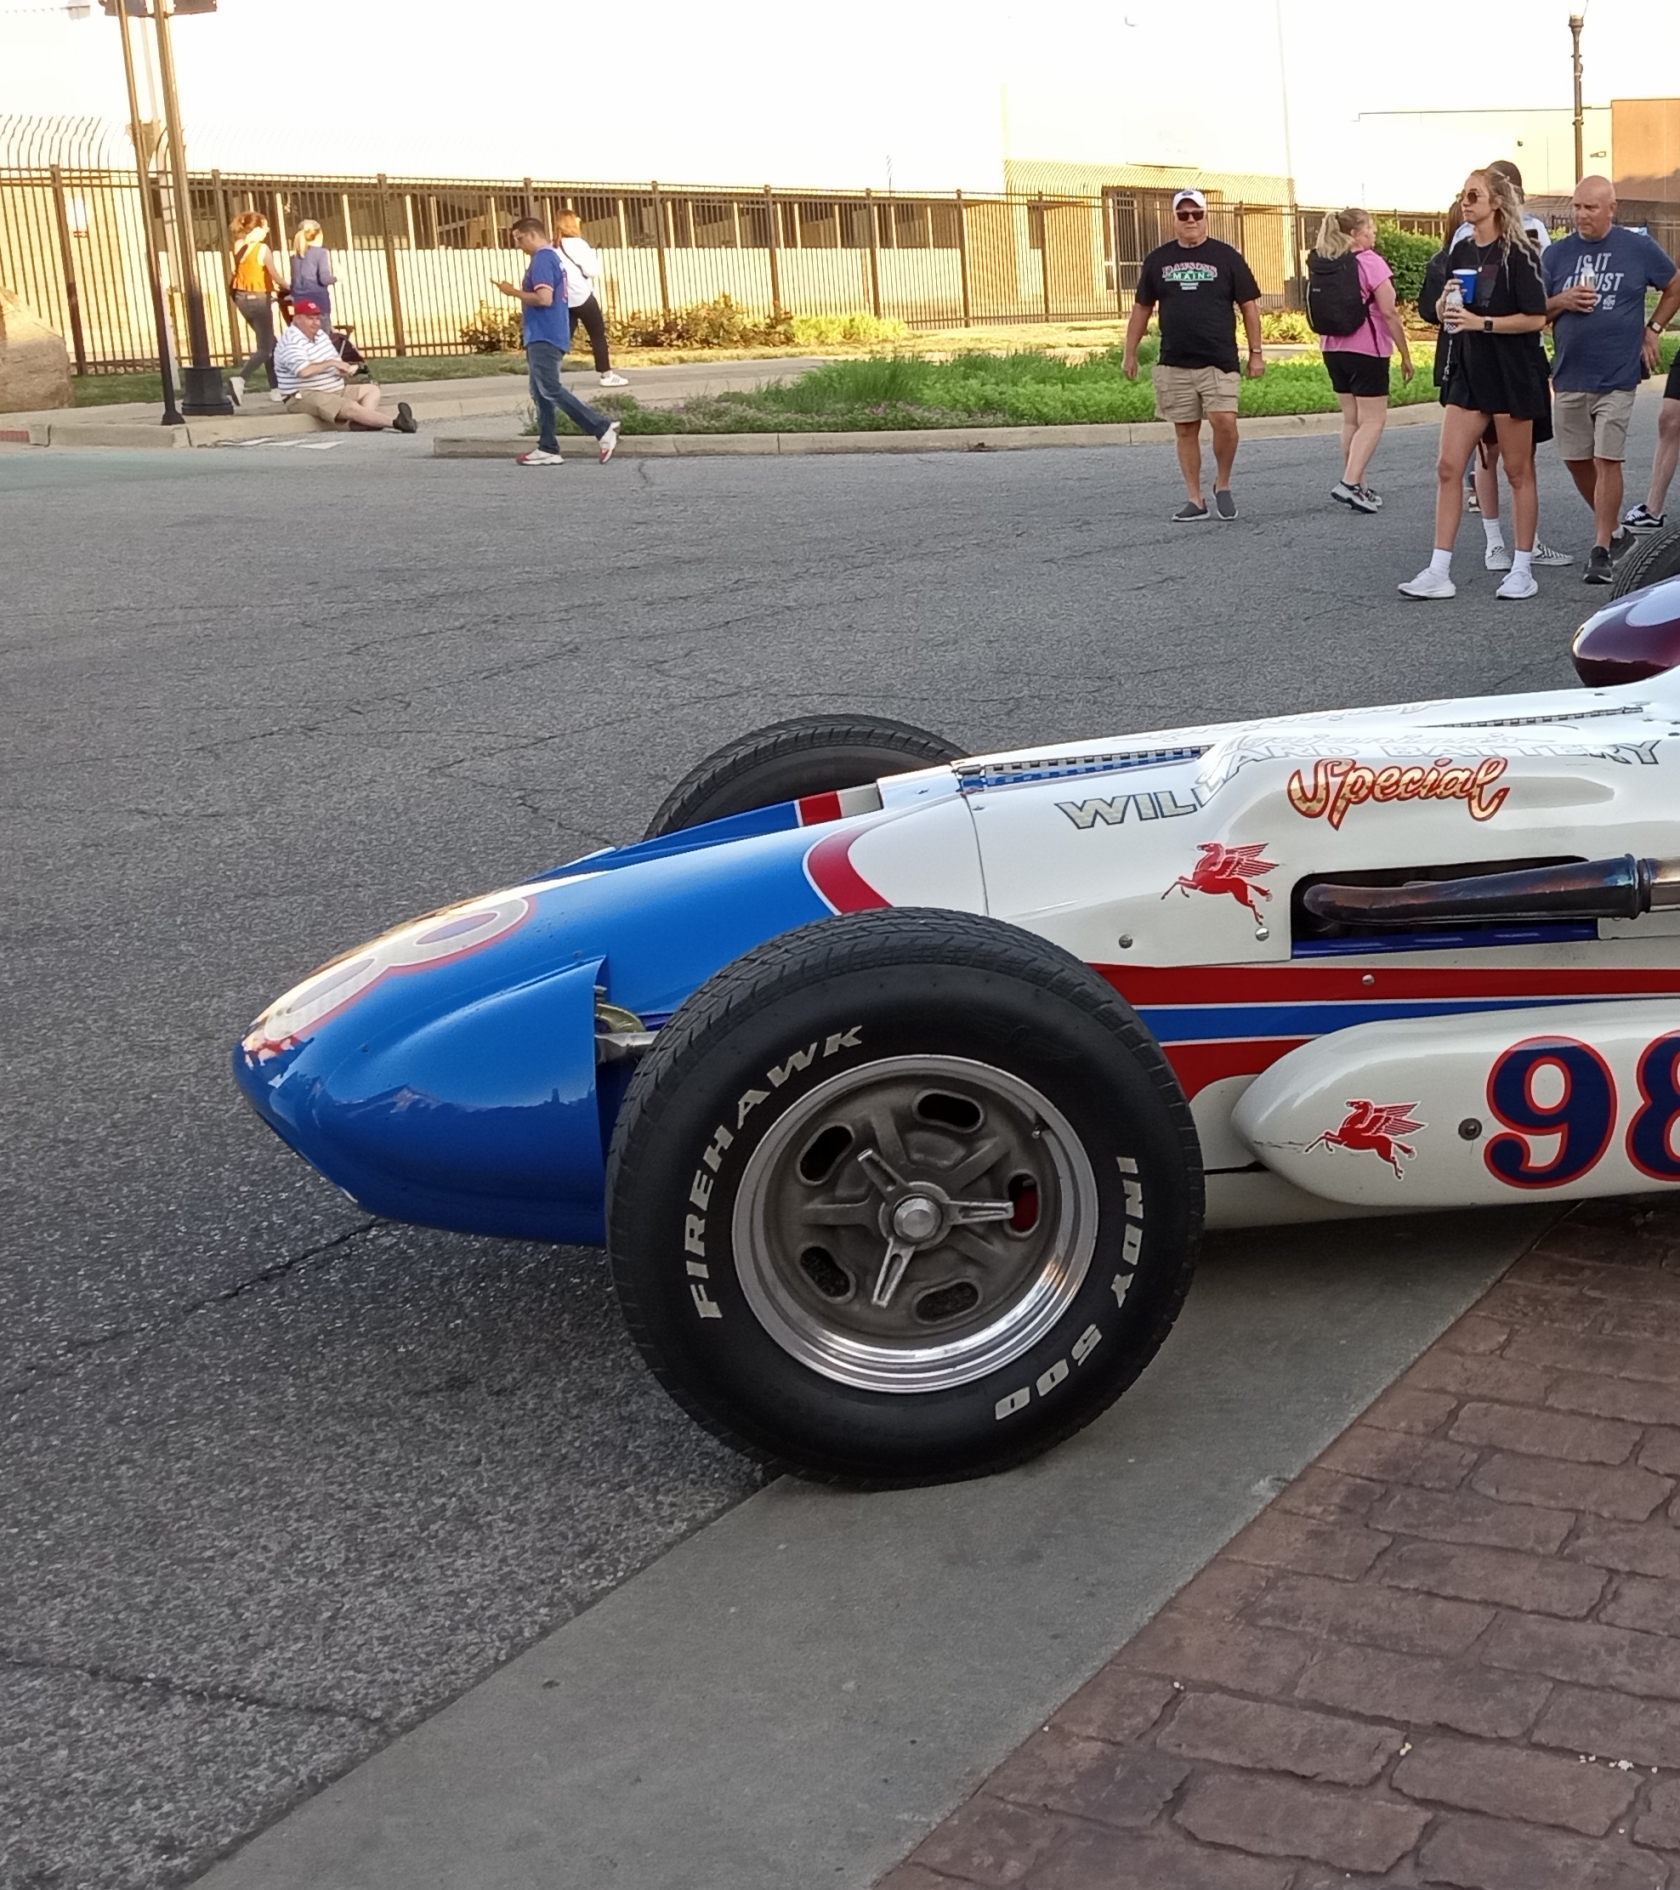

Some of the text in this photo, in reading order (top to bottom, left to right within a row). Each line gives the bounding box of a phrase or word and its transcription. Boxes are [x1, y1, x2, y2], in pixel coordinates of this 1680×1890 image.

[1594, 253, 1612, 272] IT
[1287, 757, 1511, 831] Special
[684, 1025, 864, 1320] FIREHAWK
[994, 1156, 1146, 1421] INDY 500
